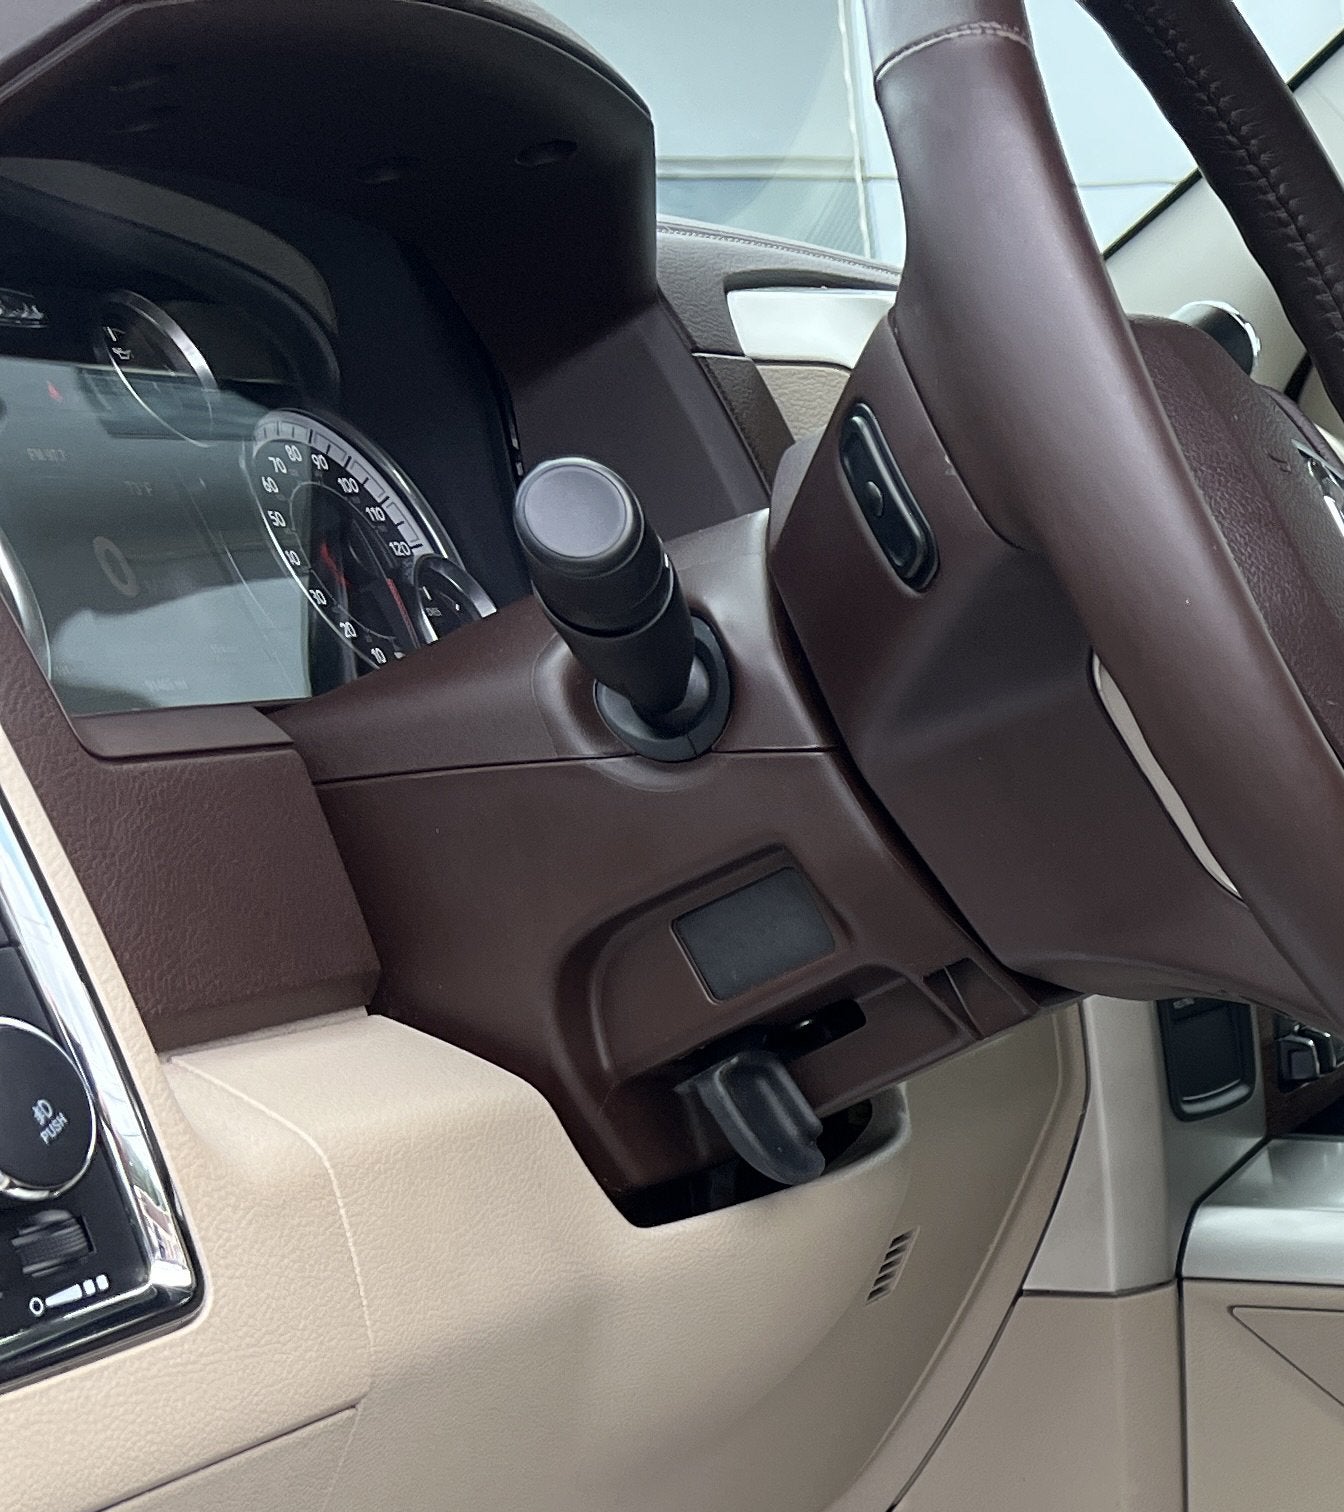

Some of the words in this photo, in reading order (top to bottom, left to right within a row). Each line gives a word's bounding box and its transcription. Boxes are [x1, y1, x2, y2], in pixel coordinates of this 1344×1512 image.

[284, 445, 302, 462] 80
[268, 456, 287, 474] 70
[311, 454, 329, 471] 90
[262, 477, 279, 493] 60
[337, 478, 359, 494] 100
[268, 510, 286, 527] 50
[366, 506, 386, 522] 110
[389, 541, 411, 557] 120
[309, 589, 327, 605] 30
[340, 621, 357, 638] 20
[371, 648, 387, 664] 10
[40, 1112, 68, 1145] PUSH
